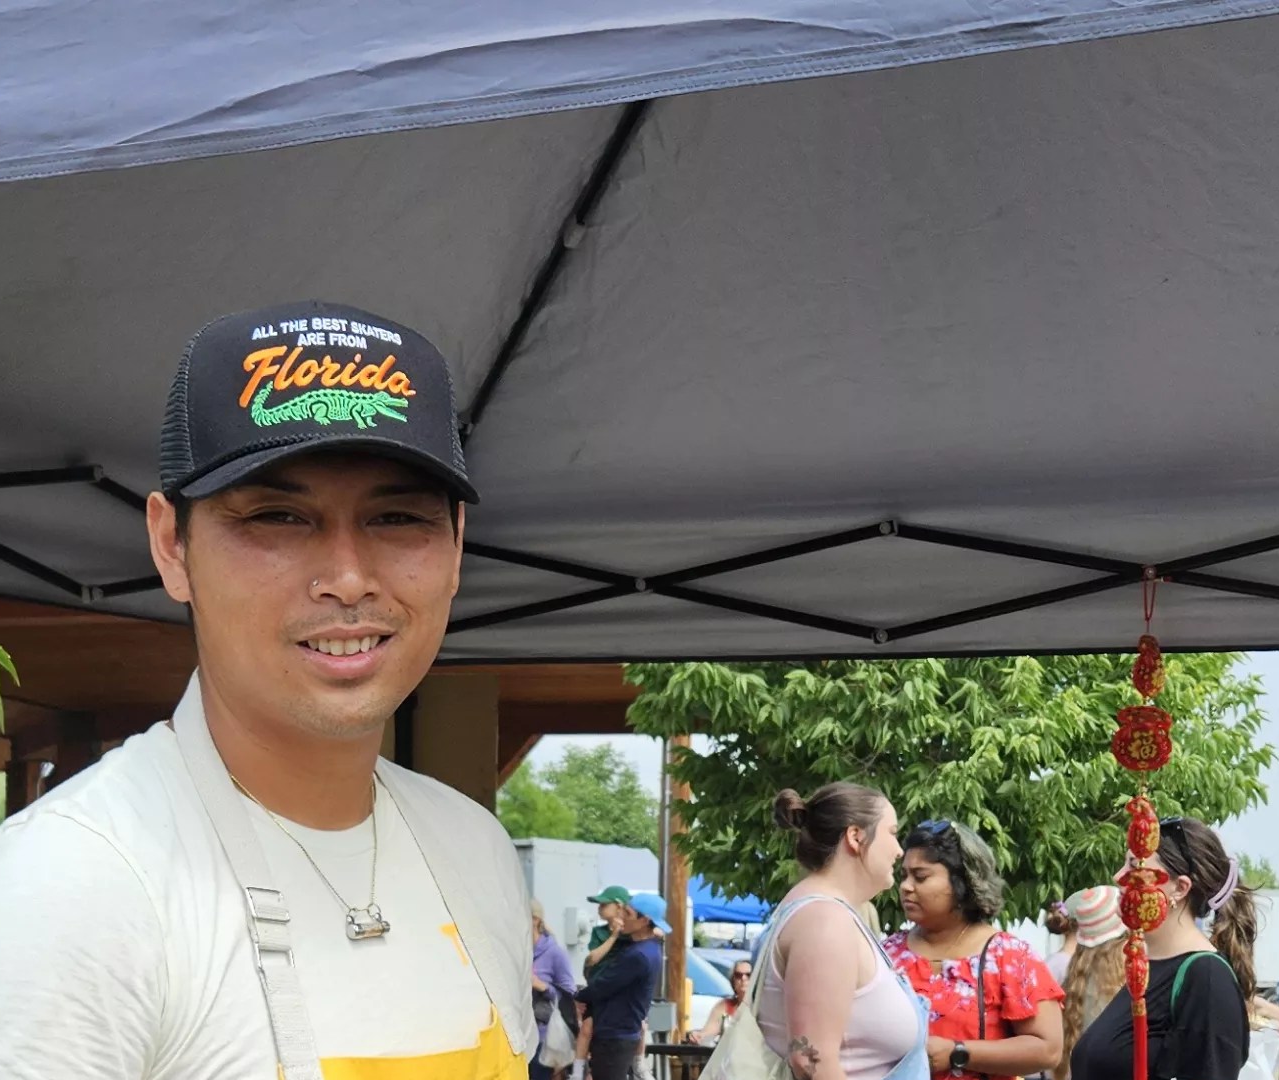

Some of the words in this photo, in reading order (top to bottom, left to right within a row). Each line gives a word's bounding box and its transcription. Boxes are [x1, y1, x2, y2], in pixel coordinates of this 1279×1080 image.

[251, 323, 278, 341] ALL
[280, 319, 309, 334] THE
[311, 317, 348, 333] BEST
[351, 320, 403, 346] SKATERS
[297, 332, 327, 348] ARE
[328, 332, 368, 350] FROM
[238, 345, 416, 409] Florida
[1127, 729, 1158, 760] 福
[1136, 891, 1161, 921] 福
